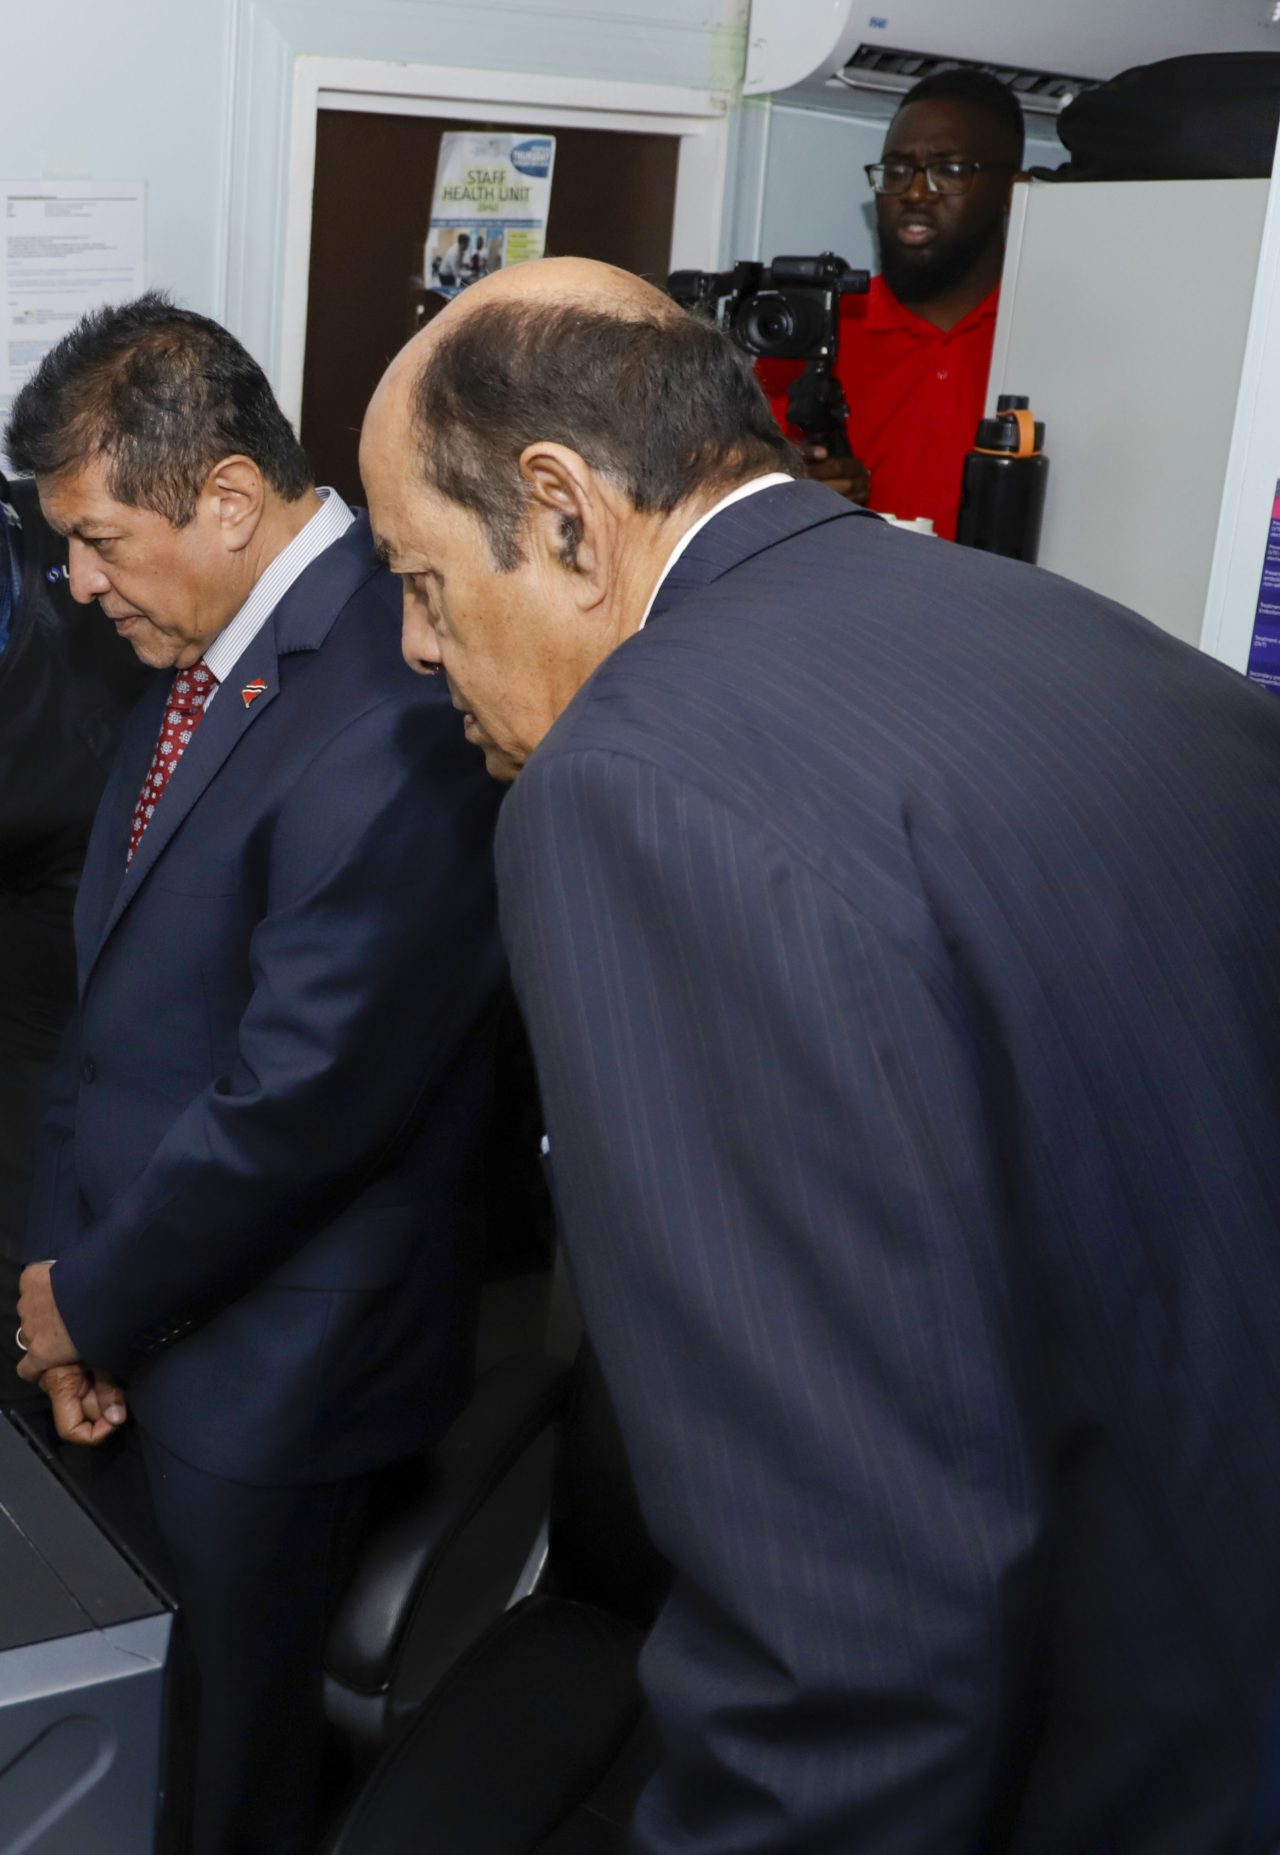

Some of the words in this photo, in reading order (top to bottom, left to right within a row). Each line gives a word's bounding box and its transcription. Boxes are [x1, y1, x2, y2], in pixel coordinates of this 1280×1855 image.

[467, 170, 507, 185] STAFF
[442, 186, 495, 201] HEALTH
[499, 187, 531, 201] UNIT
